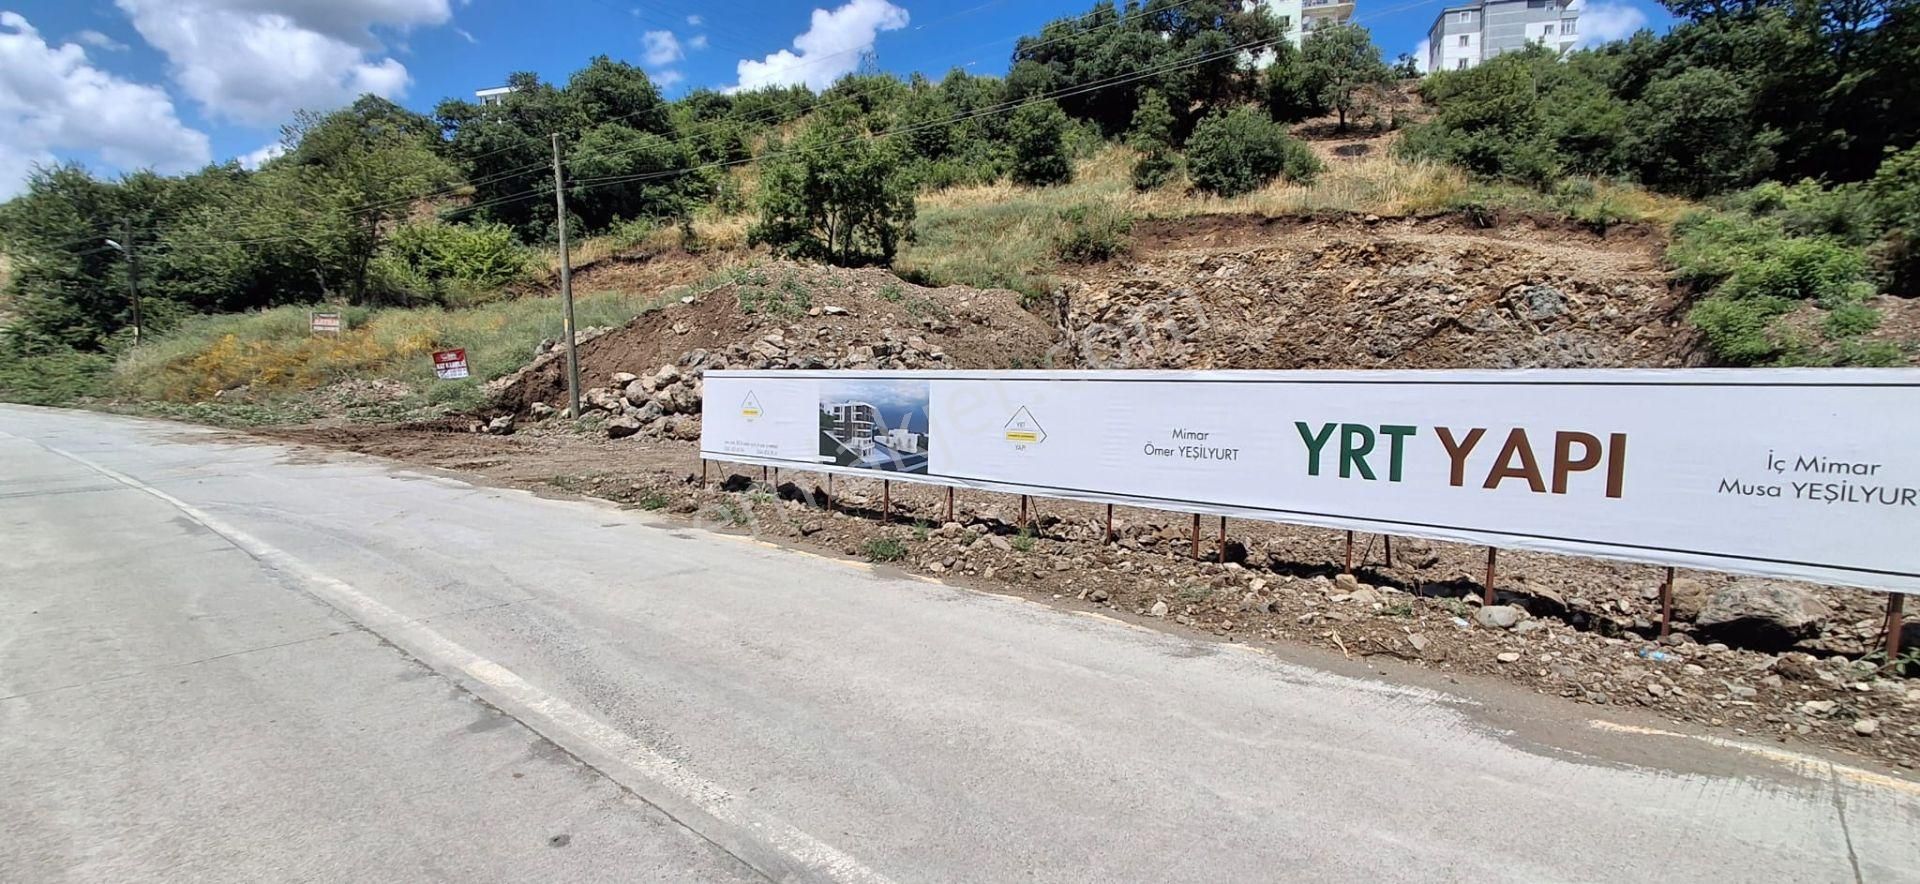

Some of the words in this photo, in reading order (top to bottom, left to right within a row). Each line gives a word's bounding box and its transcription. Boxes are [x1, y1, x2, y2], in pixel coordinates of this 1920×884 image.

[1172, 428, 1209, 441] Mimar
[1144, 440, 1175, 458] Ömer
[1178, 444, 1240, 461] YEŞİLYURT
[1294, 422, 1417, 483] YRT
[1434, 427, 1626, 498] YAPI
[1767, 449, 1787, 474] İç
[1794, 455, 1882, 476] Mimar
[1718, 478, 1781, 497] Musa
[1792, 480, 1920, 506] YEŞİLYUR
